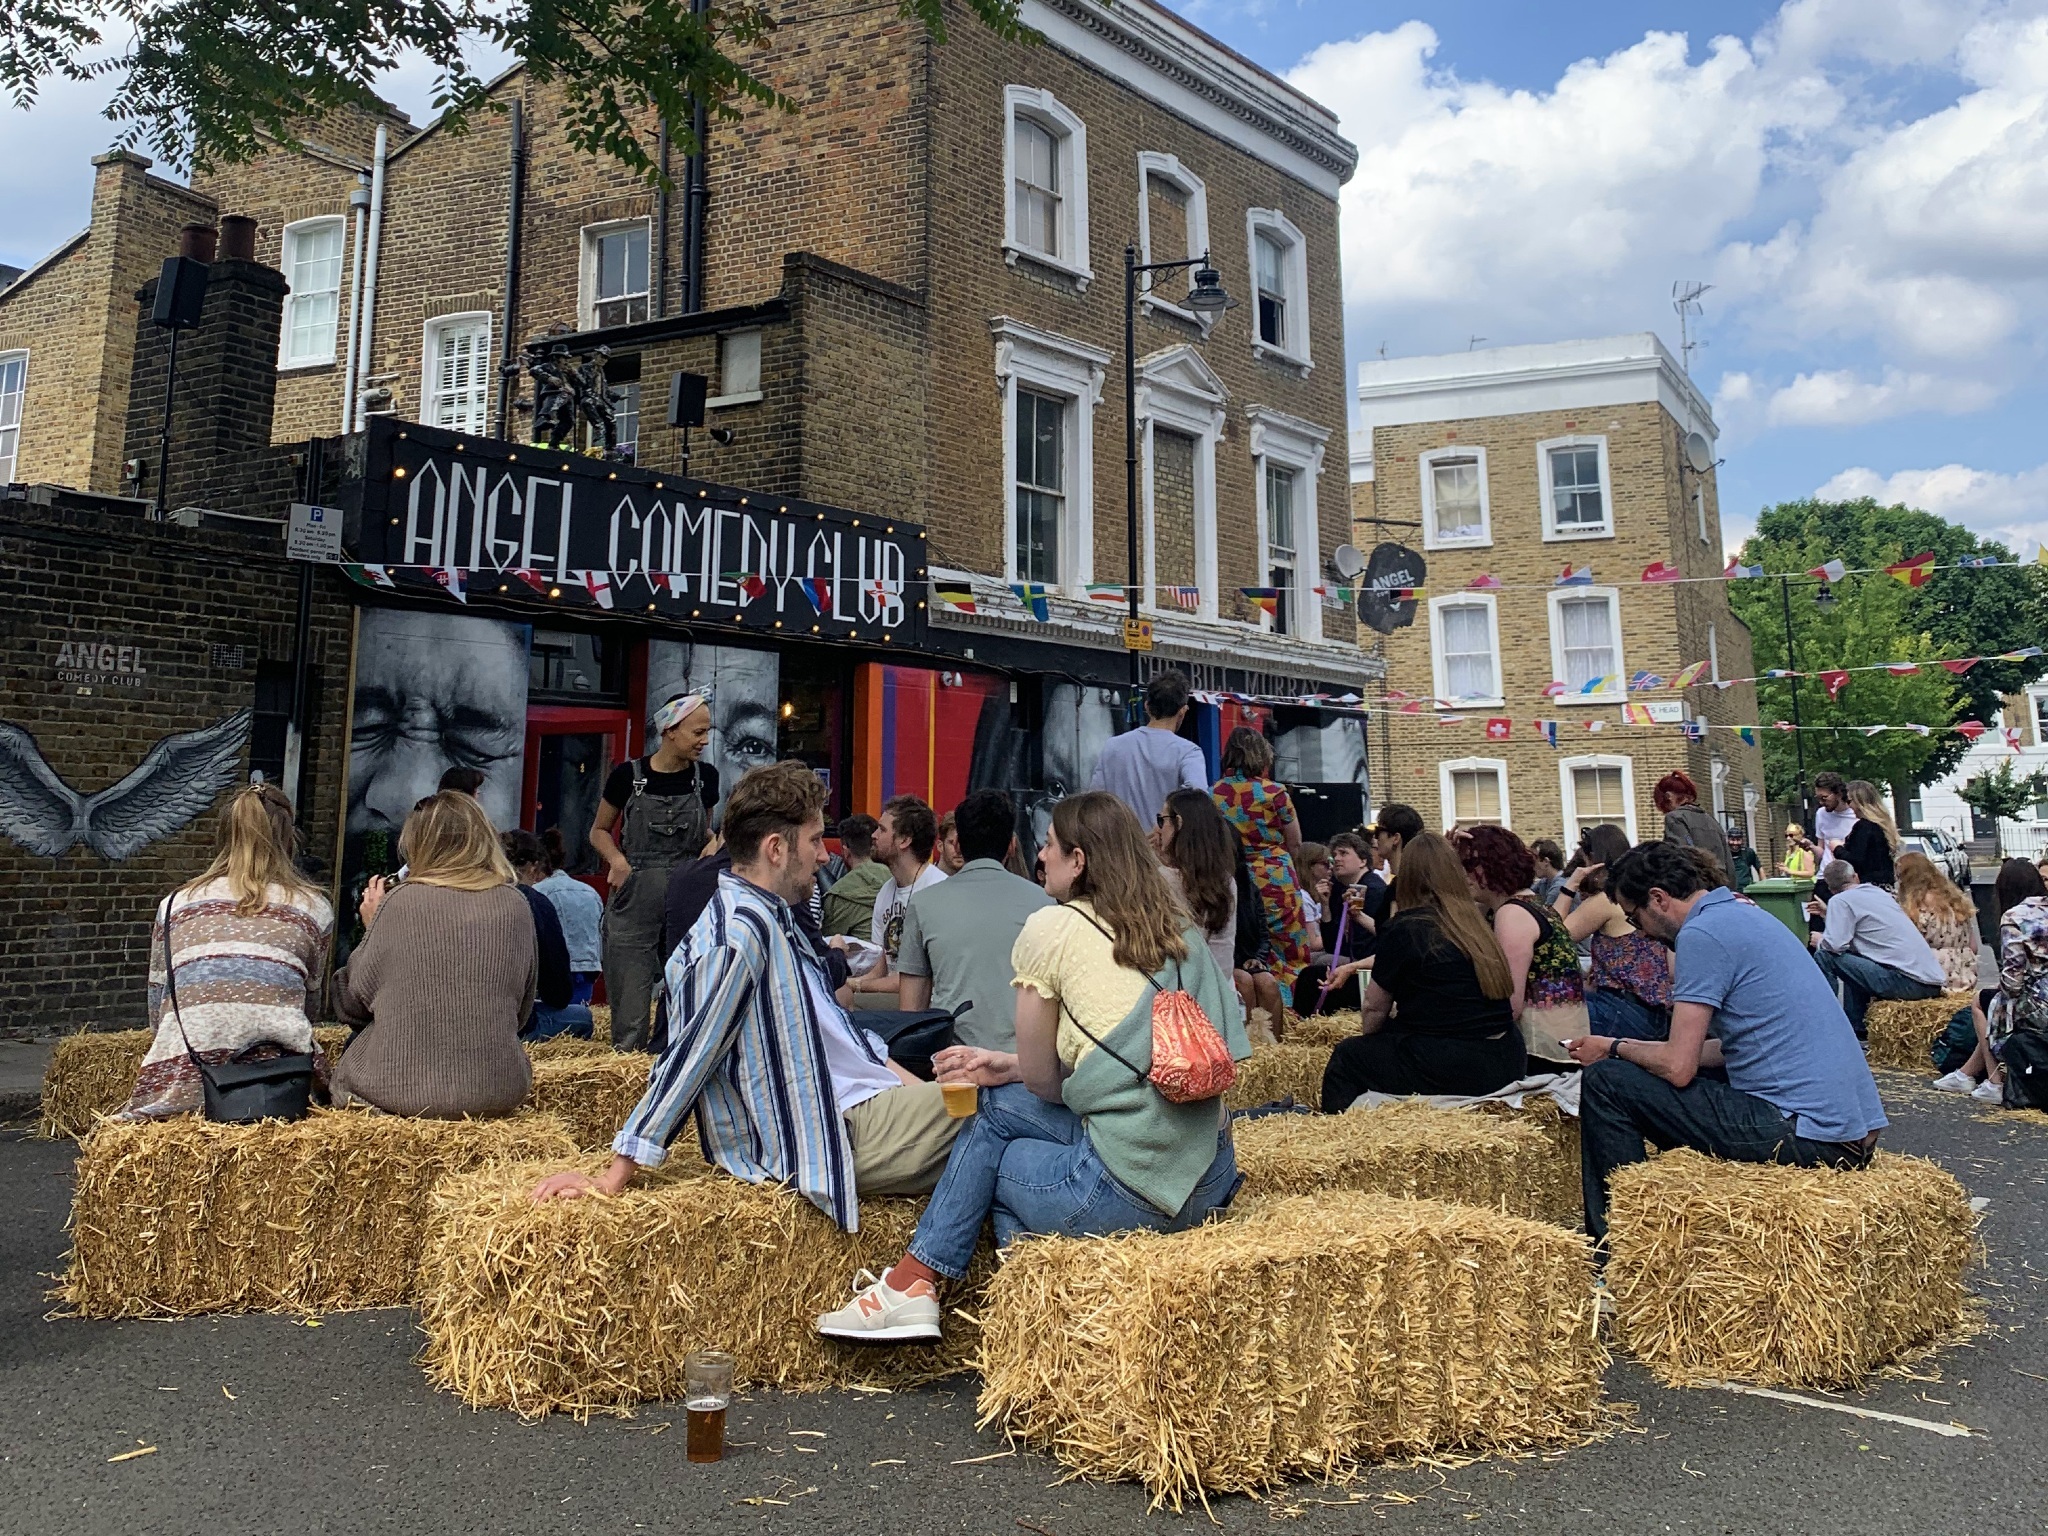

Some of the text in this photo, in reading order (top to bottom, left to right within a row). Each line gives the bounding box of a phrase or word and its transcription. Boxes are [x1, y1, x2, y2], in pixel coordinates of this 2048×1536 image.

[404, 458, 904, 628] ANGEL COMEDY CLUB
[1372, 568, 1416, 592] ANGEL
[55, 641, 148, 674] ANGEL
[57, 671, 142, 688] COMEDY CLUB
[1190, 662, 1234, 692] BILL
[1245, 671, 1320, 698] MURRAY
[1658, 706, 1679, 714] HEAD
[858, 1291, 883, 1319] N
